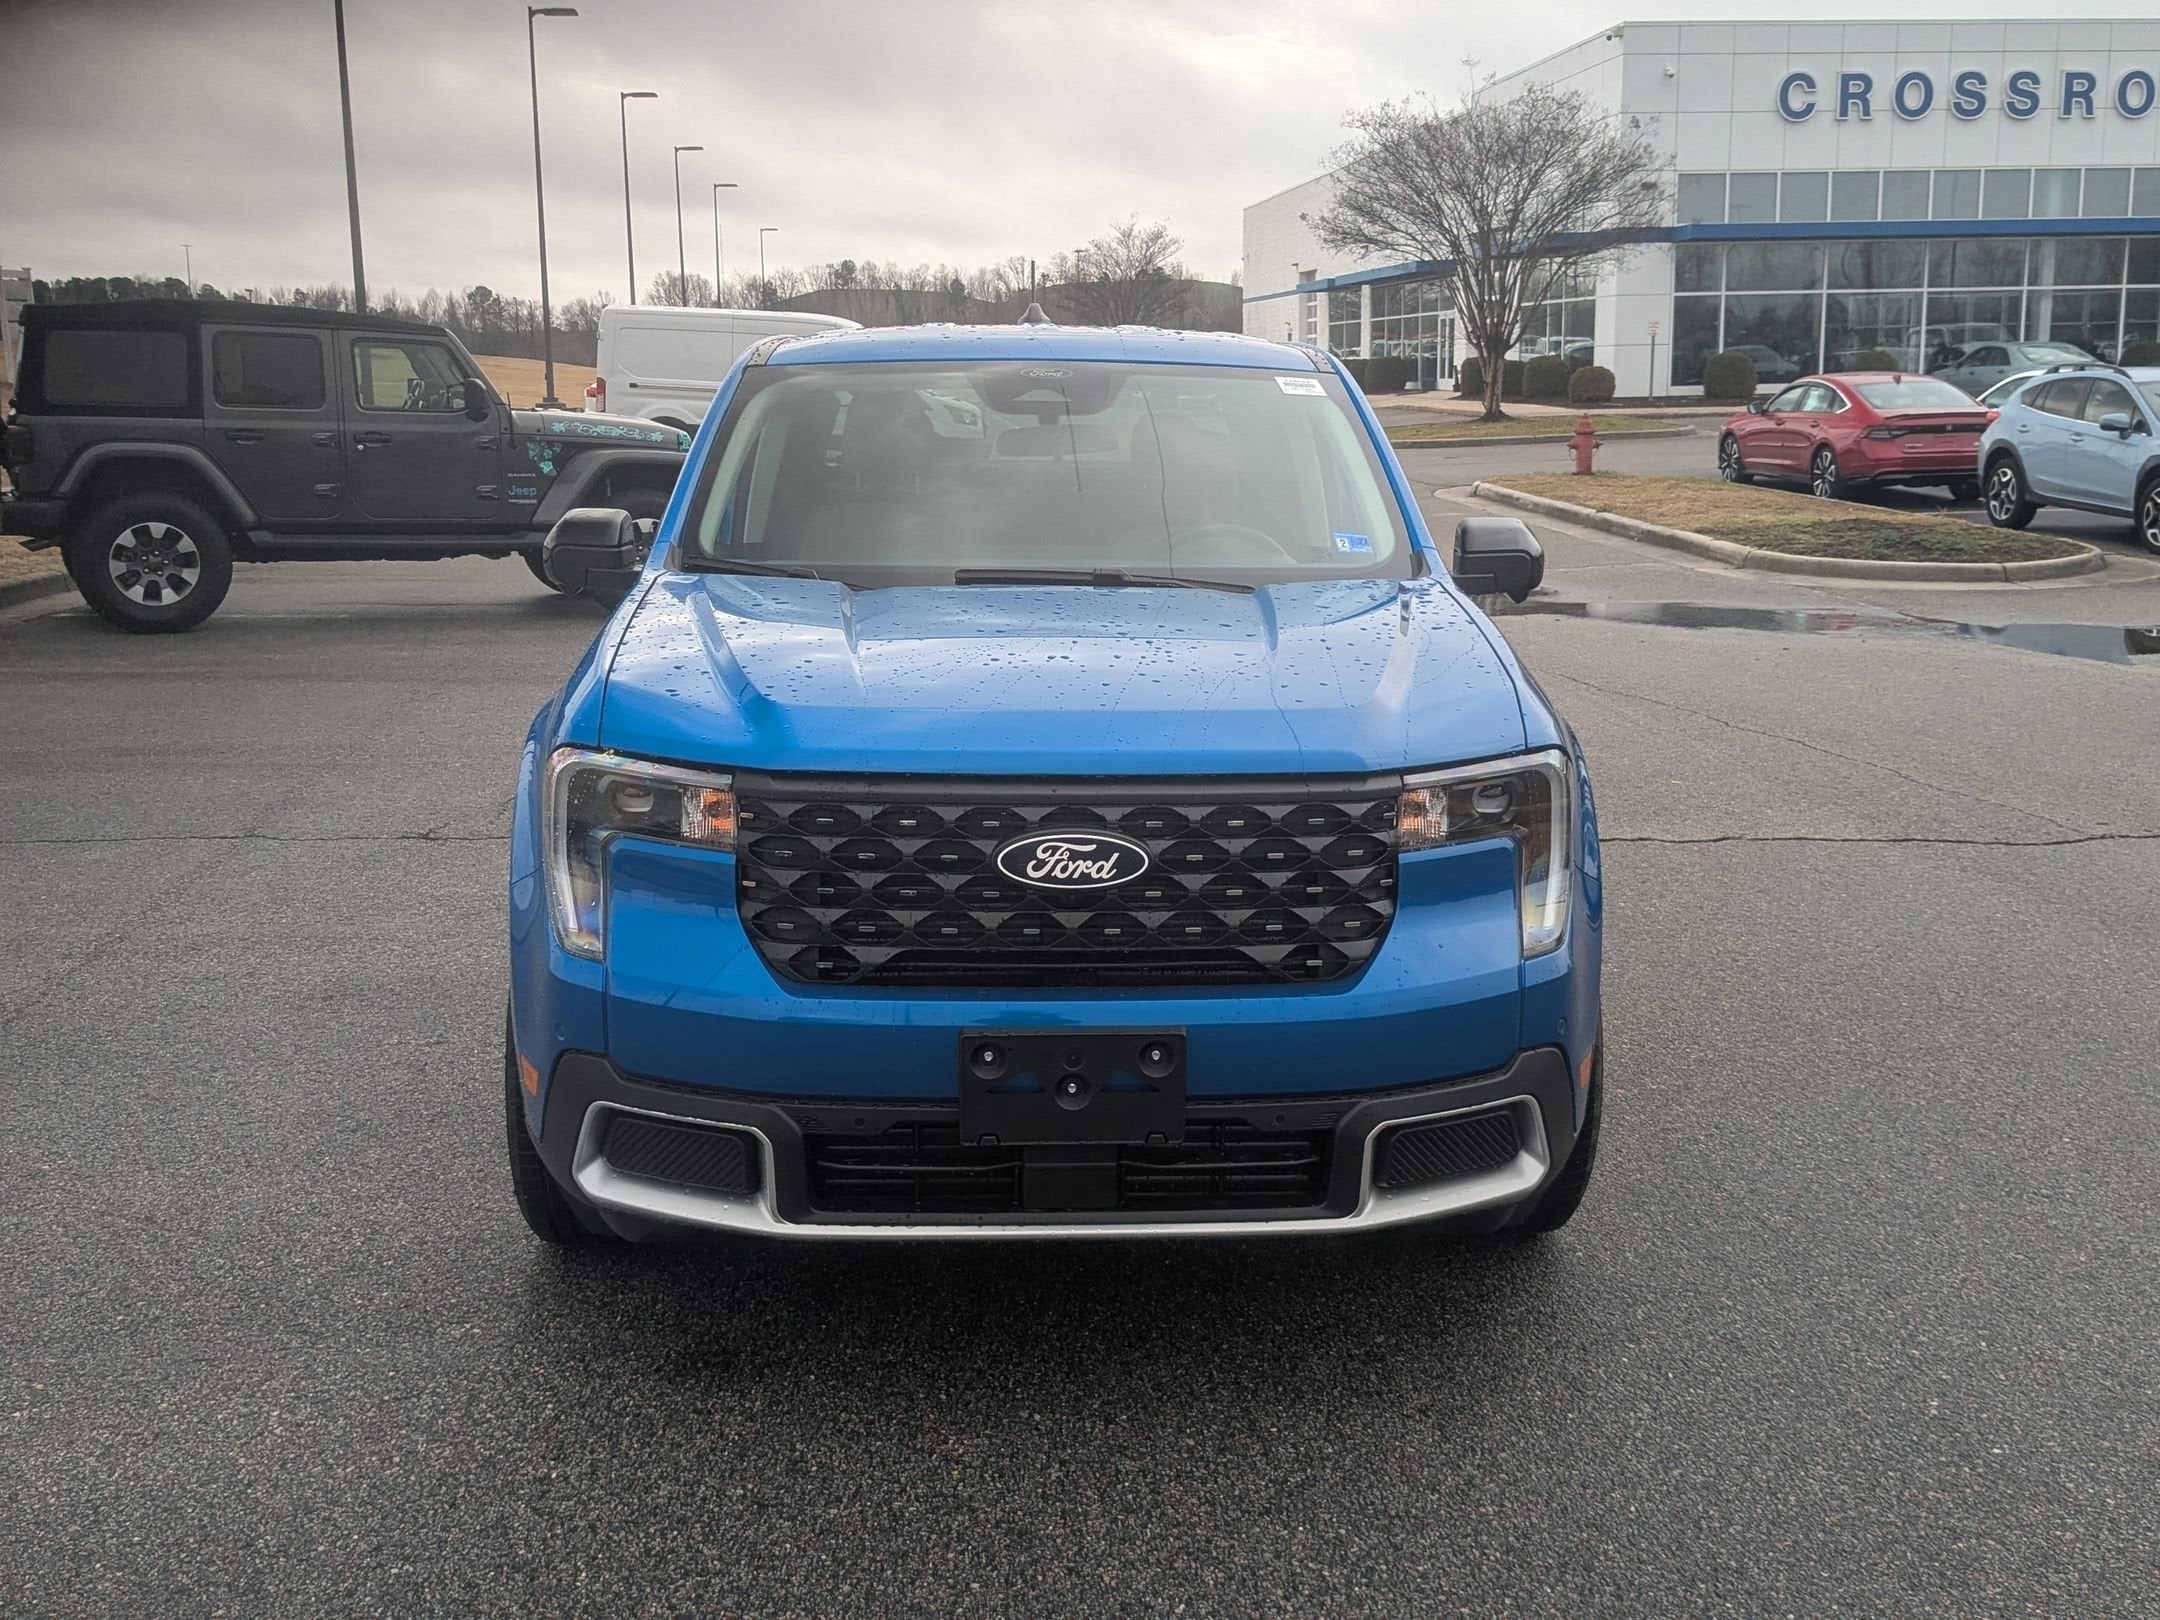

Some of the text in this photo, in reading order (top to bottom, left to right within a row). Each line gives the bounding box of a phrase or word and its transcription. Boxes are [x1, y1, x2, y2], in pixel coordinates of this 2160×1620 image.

[1776, 69, 2157, 122] CROSSRO
[1029, 368, 1064, 377] Ford
[508, 485, 537, 497] Jeep
[1339, 538, 1348, 548] 2
[1026, 841, 1119, 880] Ford
